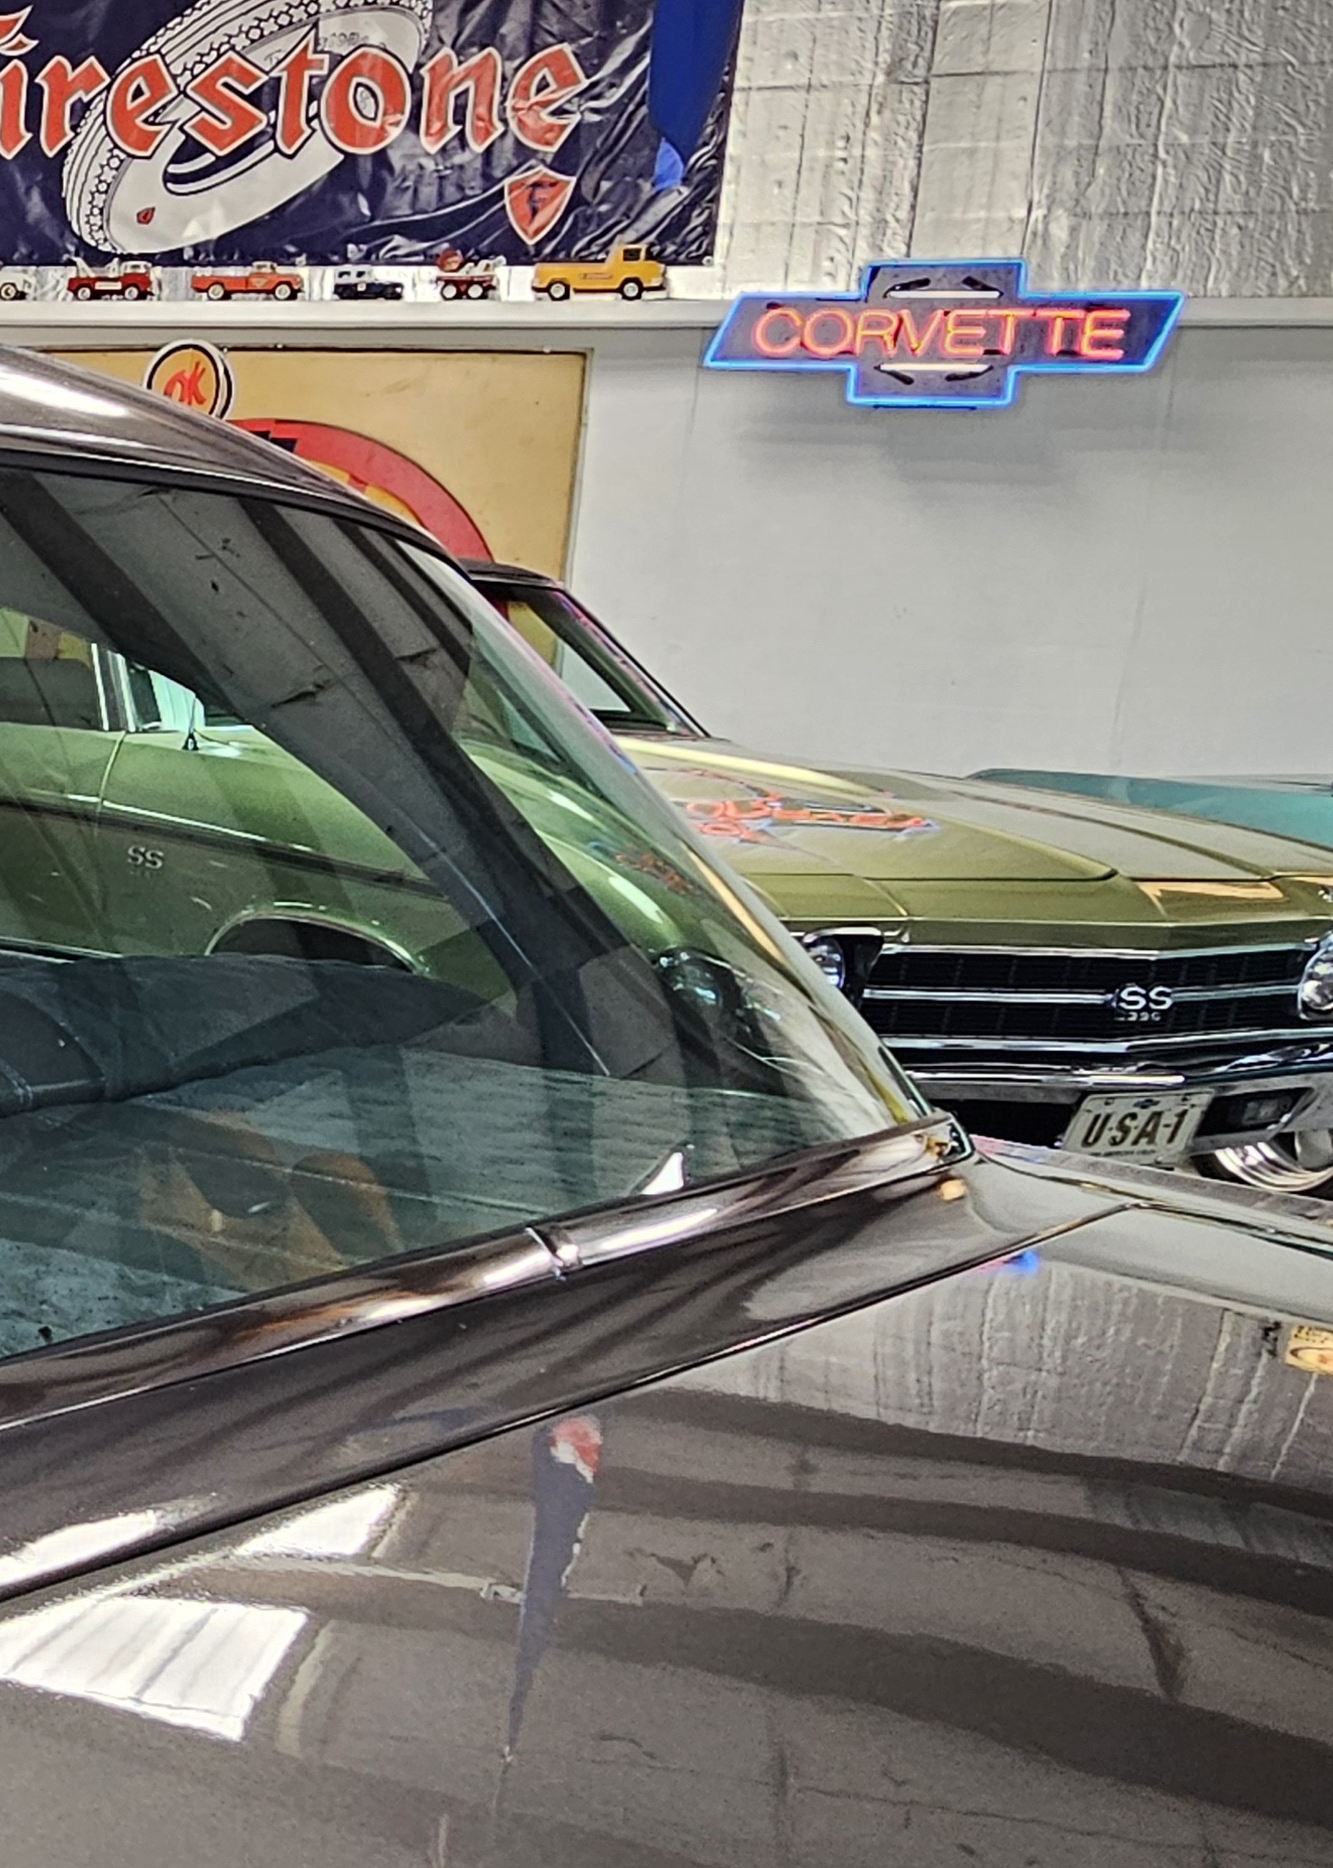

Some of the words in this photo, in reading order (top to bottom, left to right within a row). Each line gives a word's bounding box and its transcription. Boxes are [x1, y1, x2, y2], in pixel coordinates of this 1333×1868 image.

[752, 308, 1130, 360] CORVETTE
[127, 846, 164, 869] SS
[1119, 984, 1173, 1010] SS
